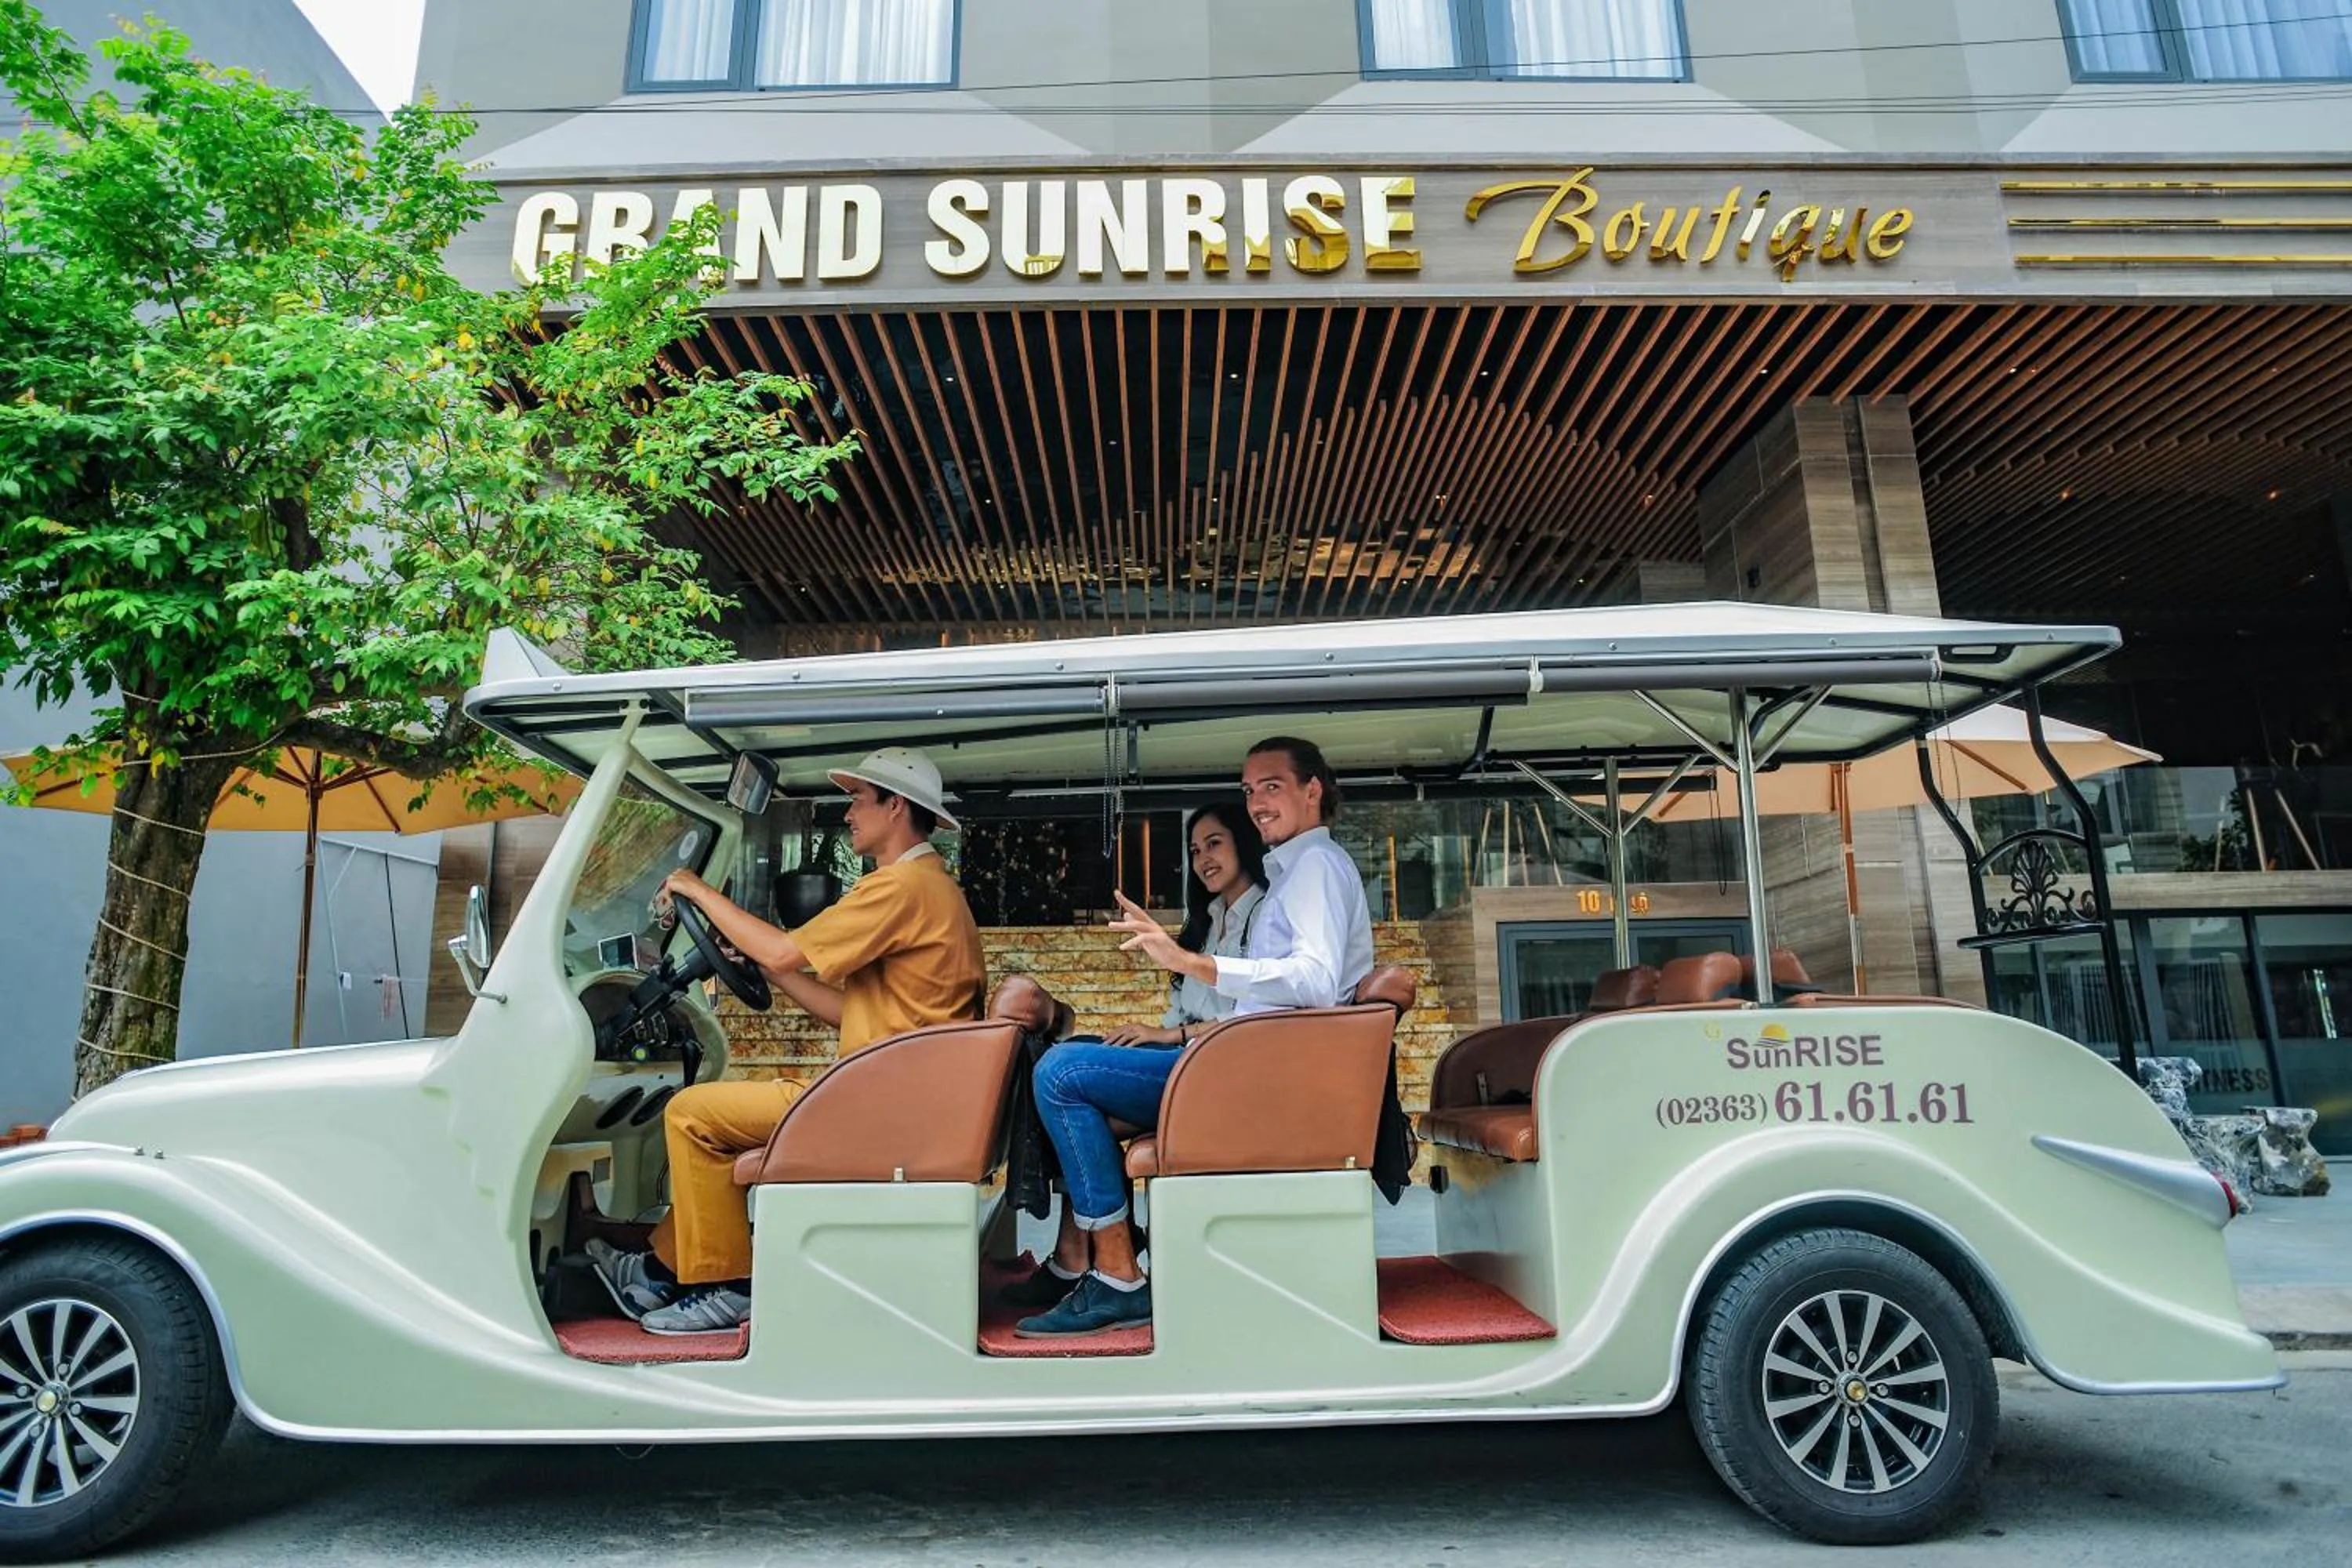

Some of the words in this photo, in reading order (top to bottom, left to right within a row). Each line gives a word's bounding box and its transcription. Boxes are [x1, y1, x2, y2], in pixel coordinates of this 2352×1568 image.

[924, 175, 1422, 277] SUNRISE
[1465, 166, 1914, 282] Boutique
[1656, 1093, 1769, 1129] (02363)
[1773, 1081, 1975, 1123] 61.61.61
